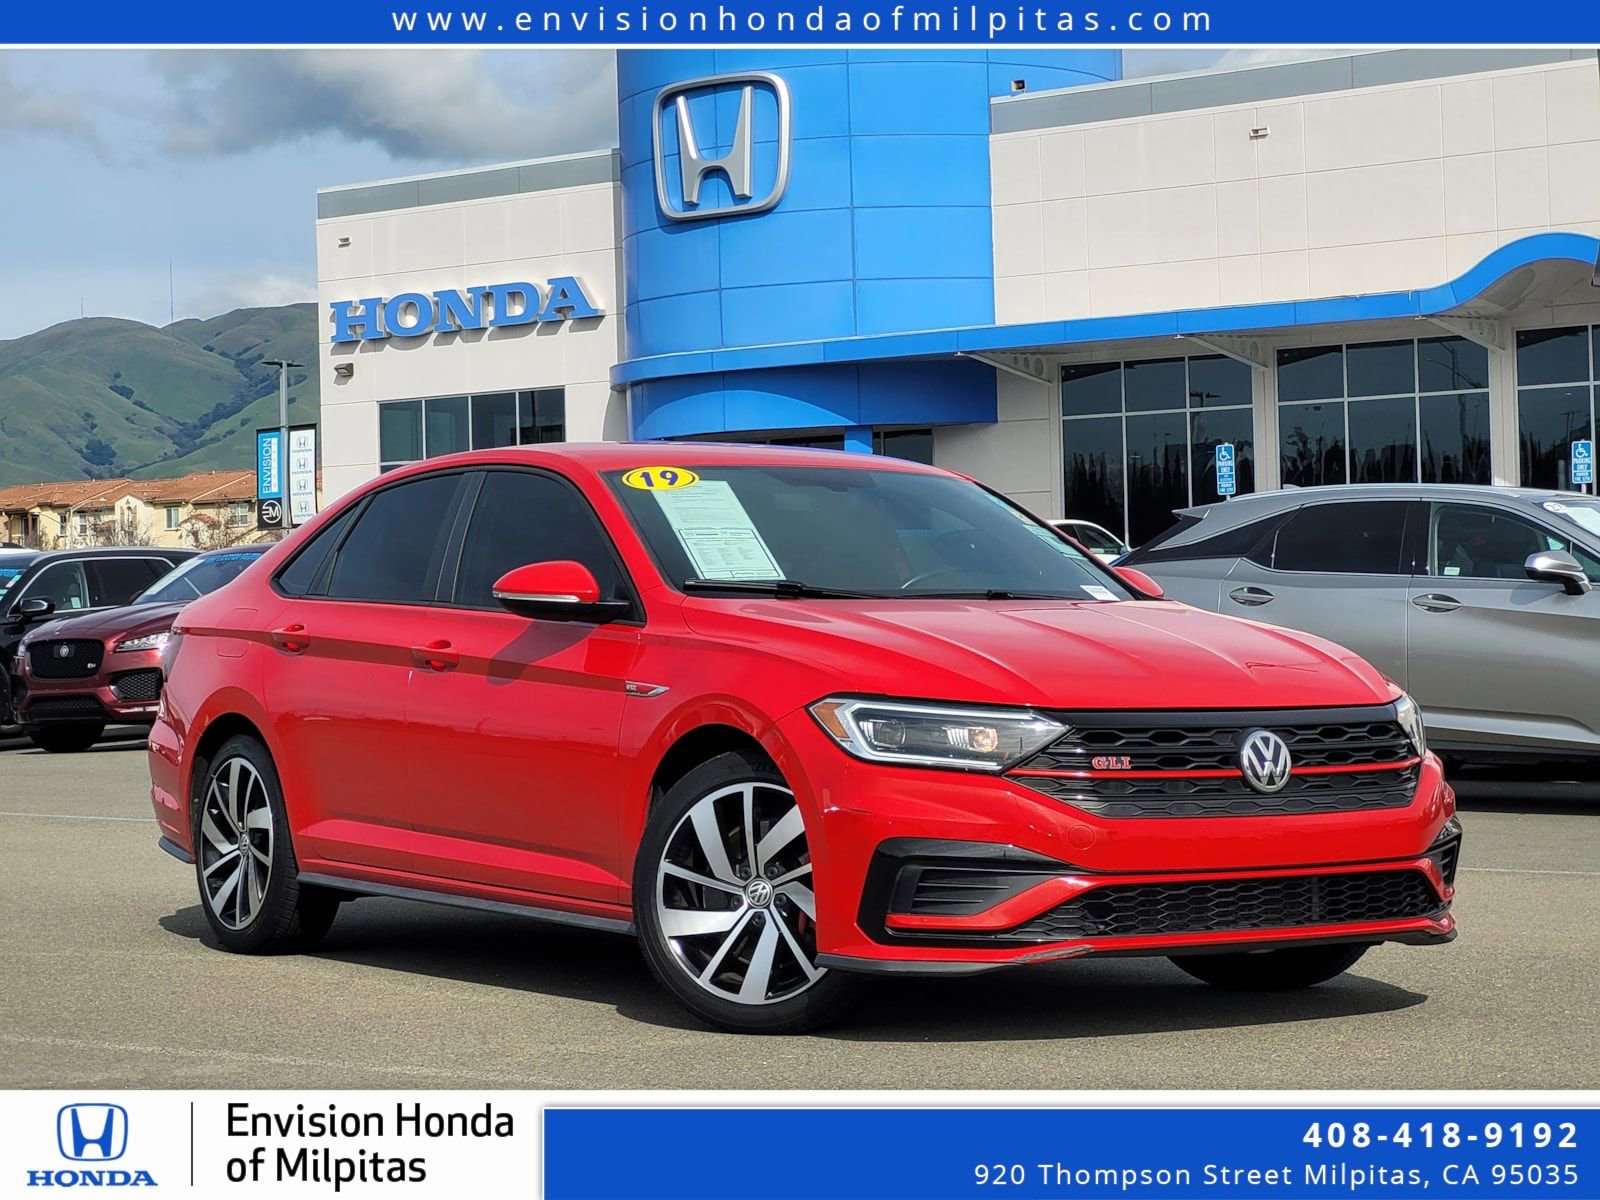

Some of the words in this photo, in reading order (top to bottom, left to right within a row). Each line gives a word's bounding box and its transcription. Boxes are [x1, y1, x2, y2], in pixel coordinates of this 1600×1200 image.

[329, 276, 606, 343] HONDA
[262, 438, 272, 494] ENVISION
[640, 470, 679, 487] 19
[1091, 756, 1132, 770] GLI
